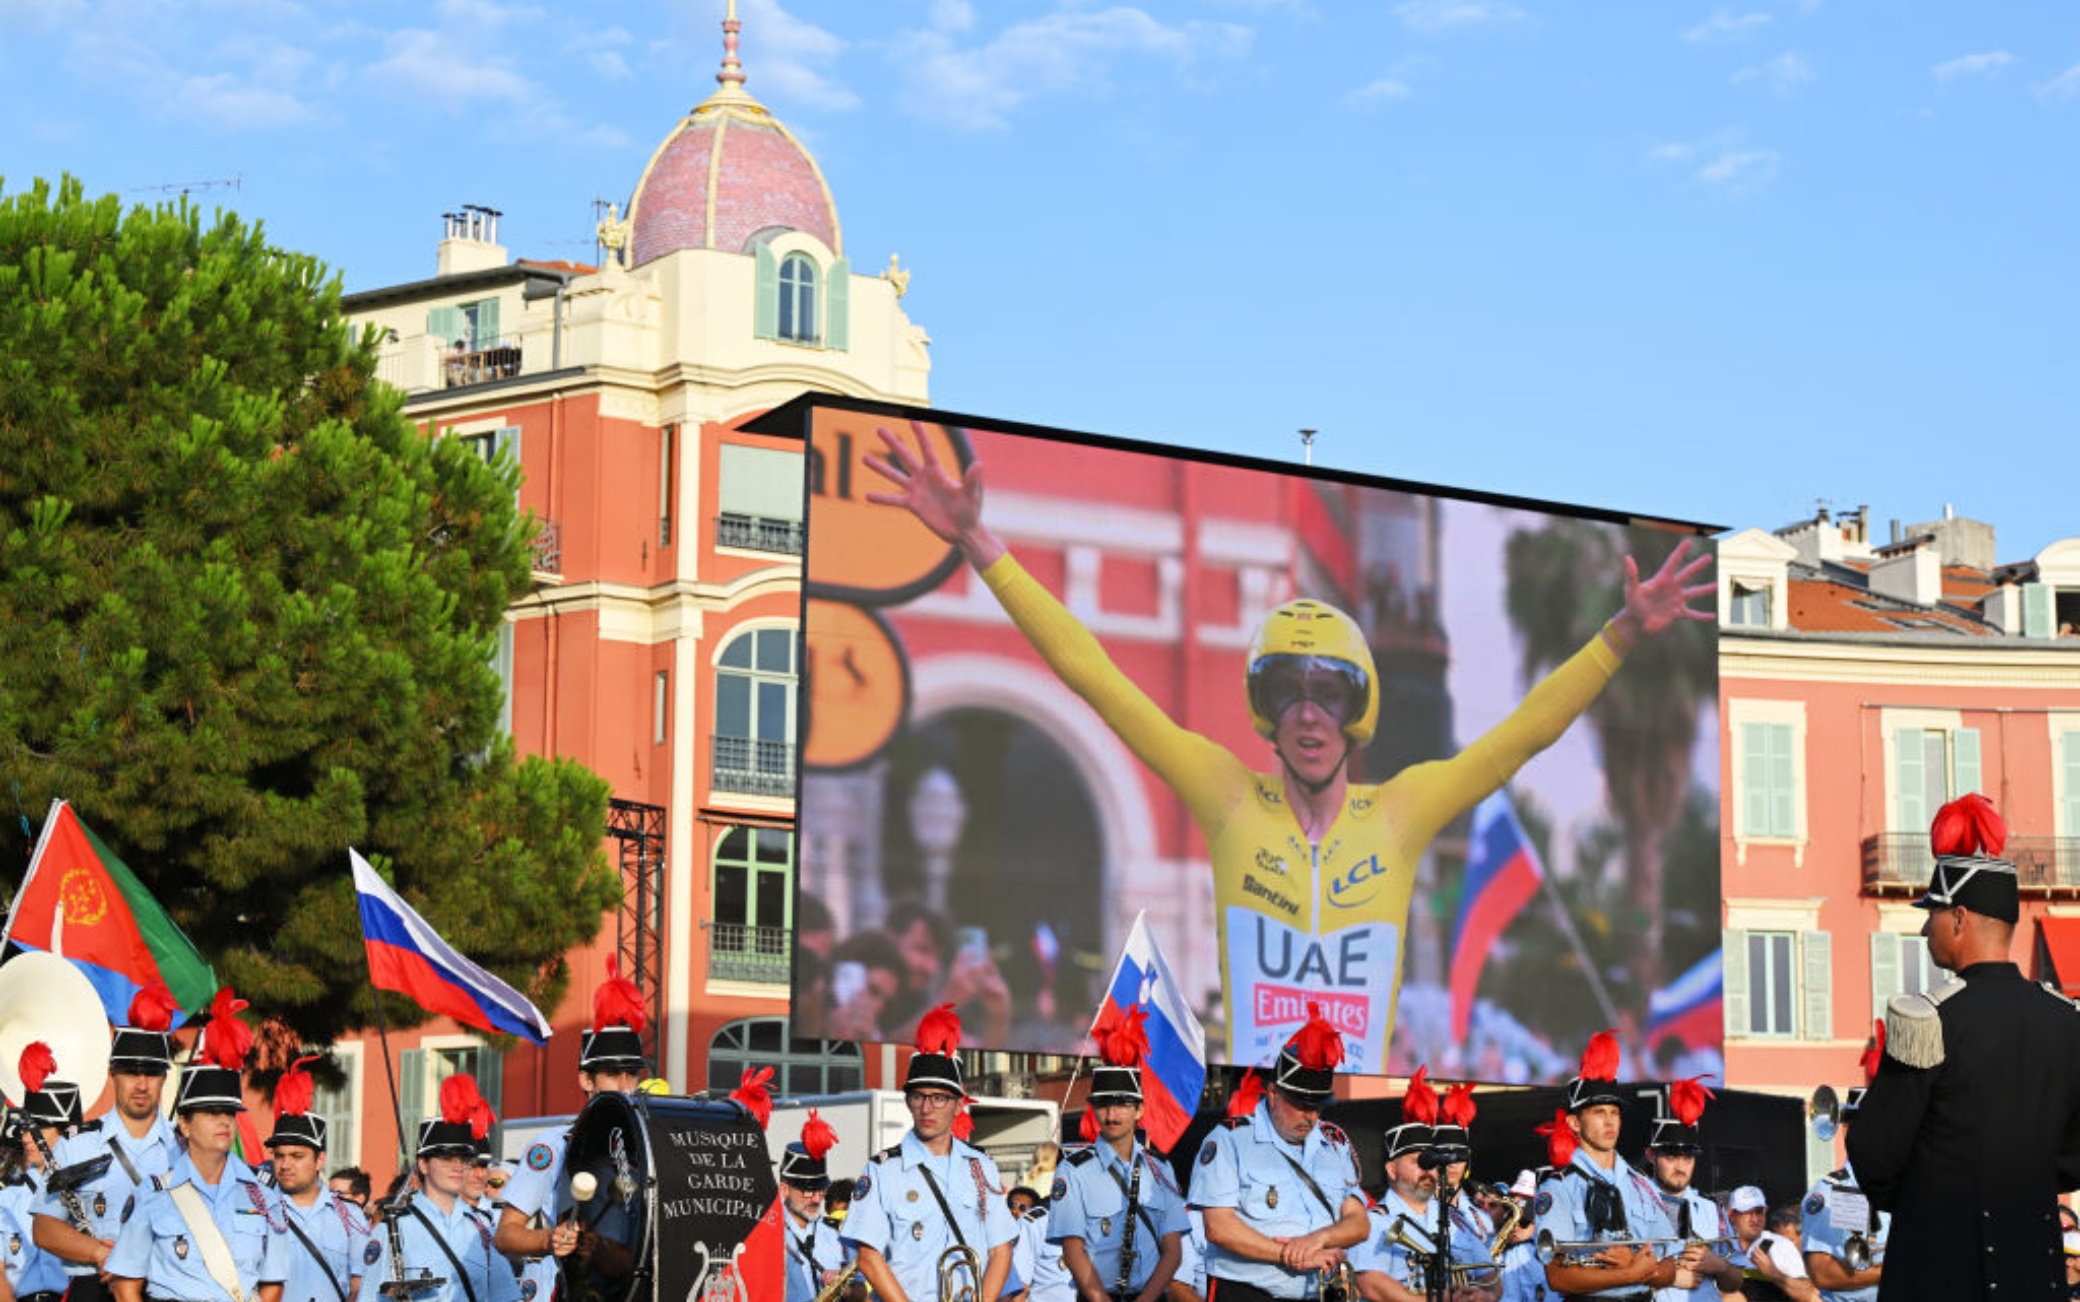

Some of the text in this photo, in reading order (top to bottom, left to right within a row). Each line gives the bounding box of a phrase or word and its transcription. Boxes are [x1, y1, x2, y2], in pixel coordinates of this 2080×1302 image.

[1332, 854, 1387, 894] LCL
[1242, 873, 1300, 915] Santini
[1256, 915, 1371, 986] UAE
[1258, 989, 1366, 1031] Emiates
[669, 1132, 759, 1149] MUSIQUE
[689, 1152, 746, 1169] DE LA
[687, 1174, 754, 1193] GARDE
[663, 1199, 778, 1226] MUNICIPALE
